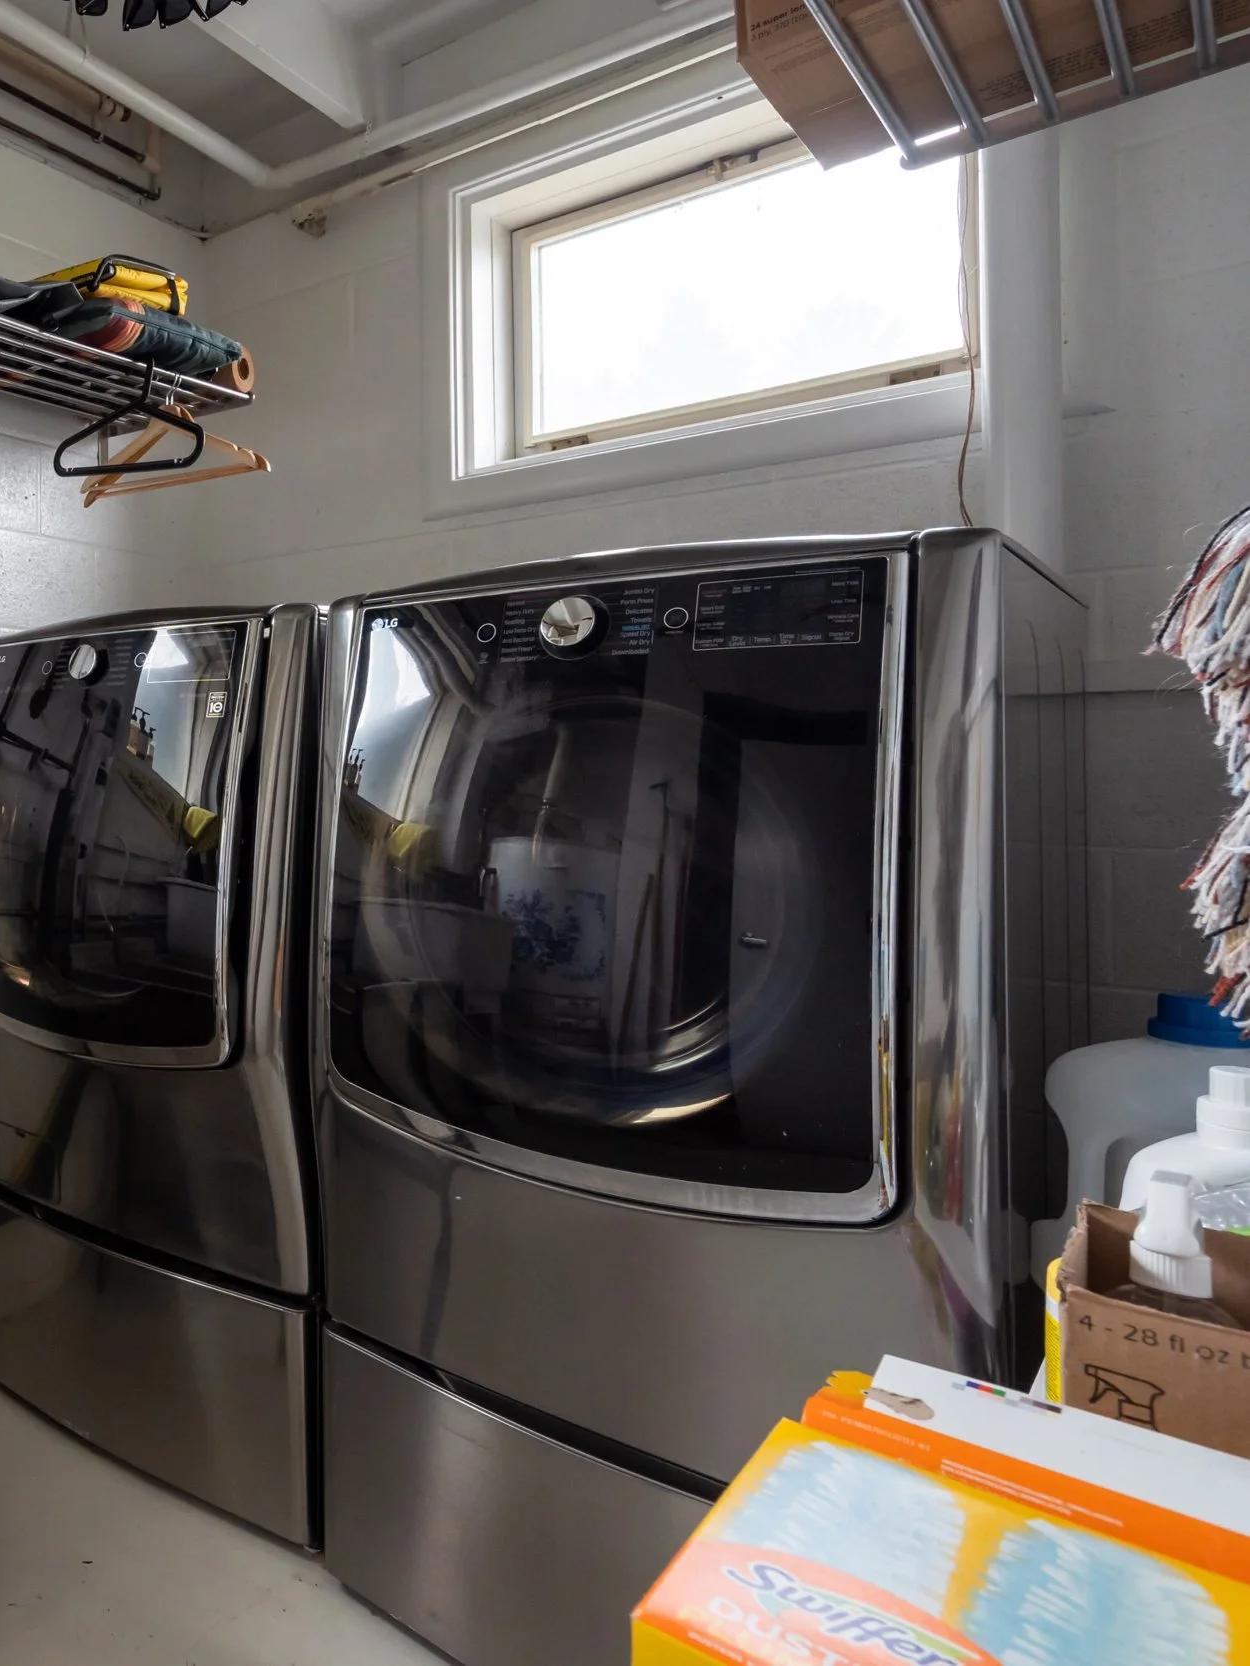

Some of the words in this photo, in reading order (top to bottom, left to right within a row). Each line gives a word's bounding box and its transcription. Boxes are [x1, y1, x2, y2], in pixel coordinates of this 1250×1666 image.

[762, 11, 789, 27] super
[643, 587, 656, 595] Dry
[384, 617, 399, 628] LG
[639, 639, 651, 647] Dry
[801, 633, 822, 642] Signal
[611, 648, 651, 657] Downloaded
[1079, 1314, 1095, 1332] 4
[1123, 1322, 1159, 1347] 28
[1169, 1334, 1185, 1354] fl
[1194, 1345, 1230, 1364] oz
[723, 1561, 958, 1666] Swiffer
[707, 1595, 852, 1666] DUST
